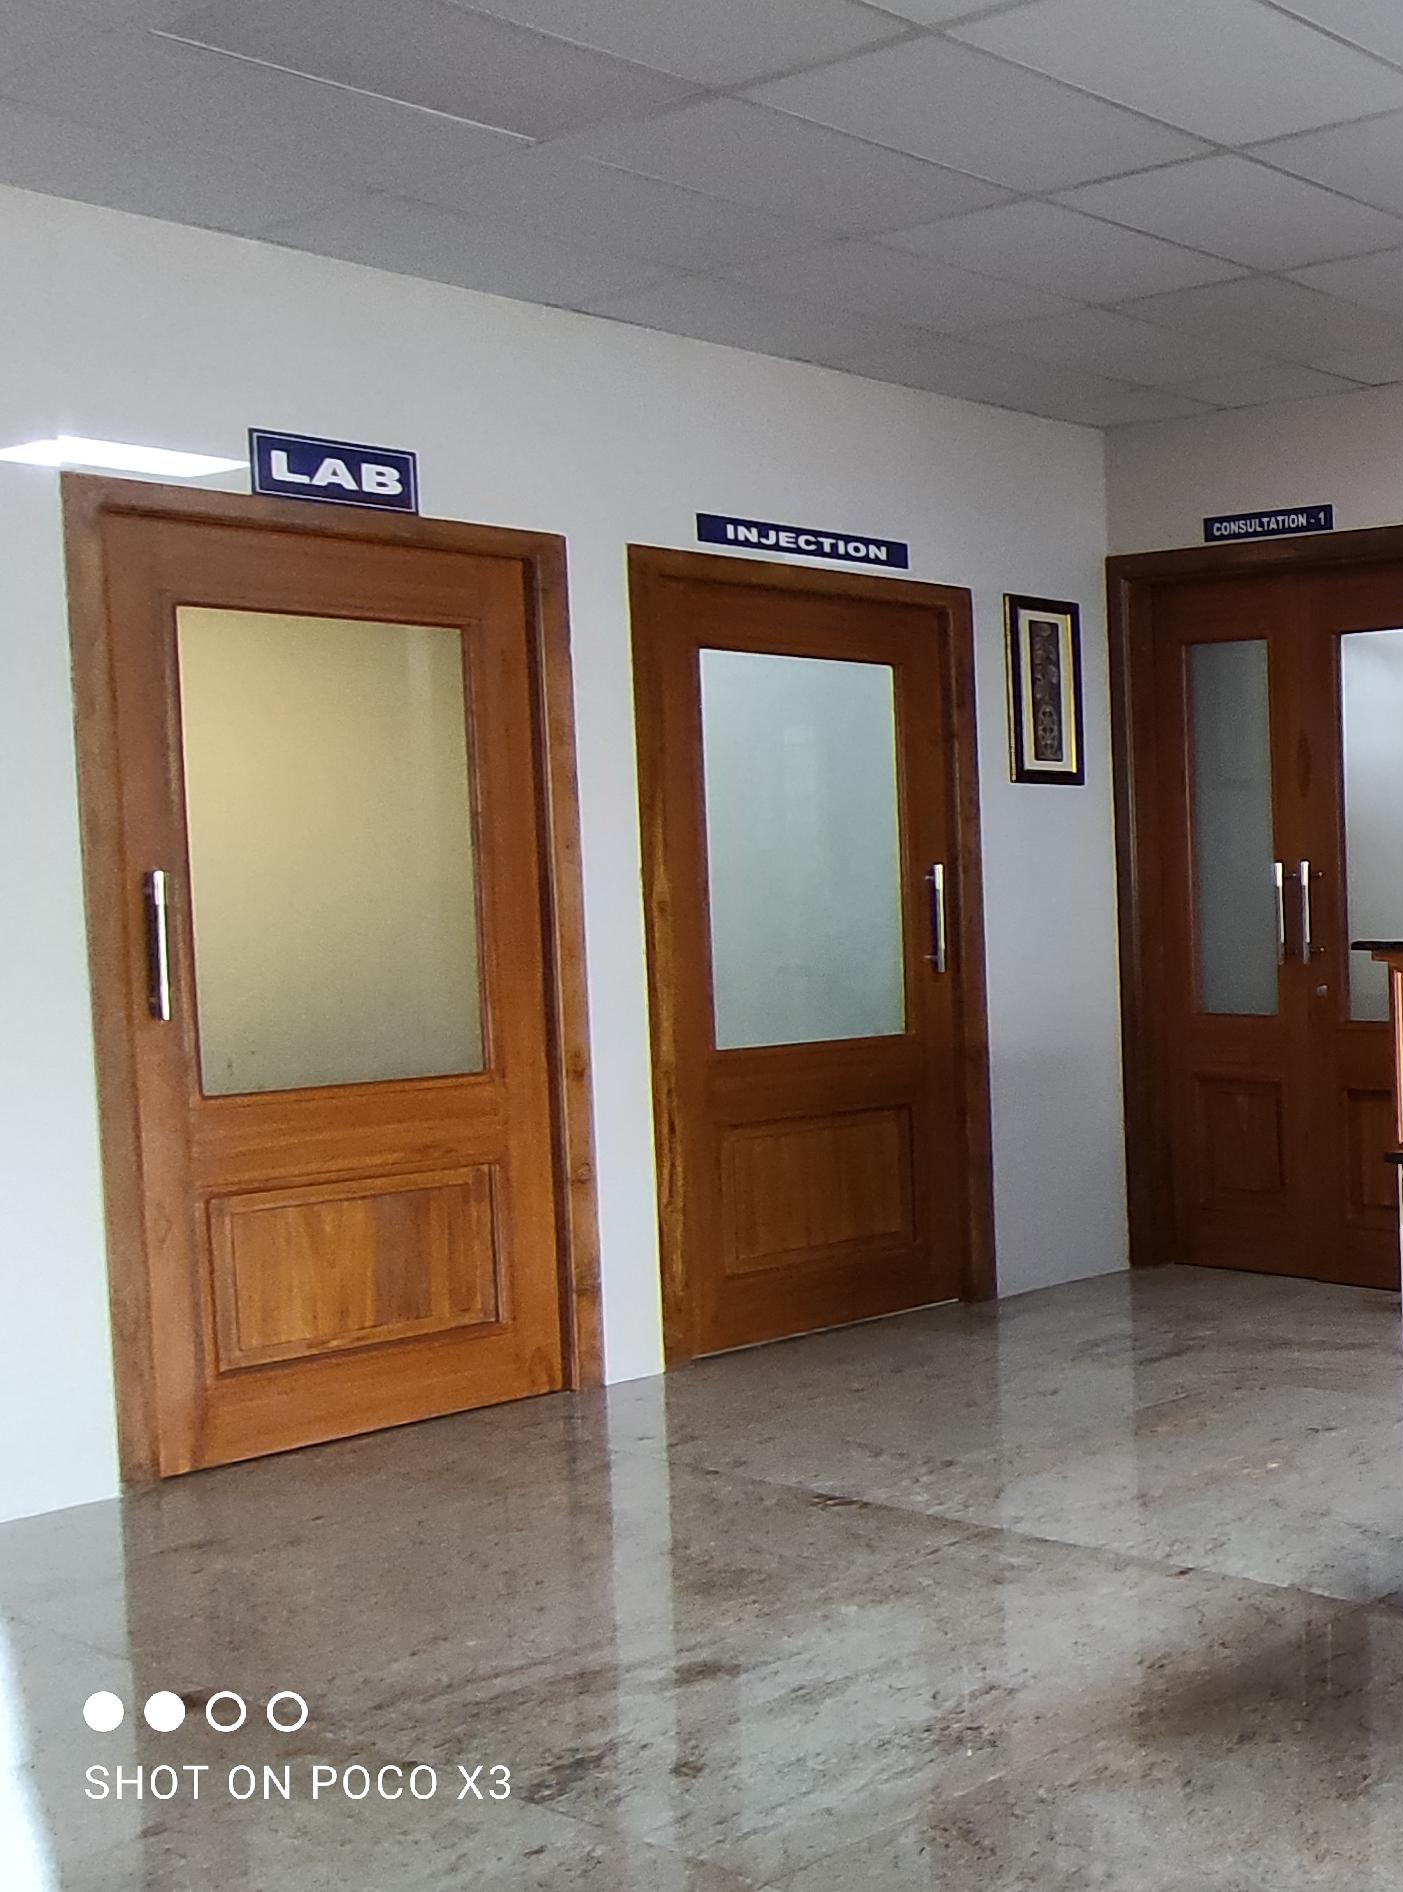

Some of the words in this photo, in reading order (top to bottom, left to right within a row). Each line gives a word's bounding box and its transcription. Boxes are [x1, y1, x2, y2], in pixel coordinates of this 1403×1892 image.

[269, 449, 403, 496] LAB
[725, 523, 888, 561] INJECTION
[1213, 512, 1307, 536] CONSULTATION
[1318, 511, 1325, 526] 1
